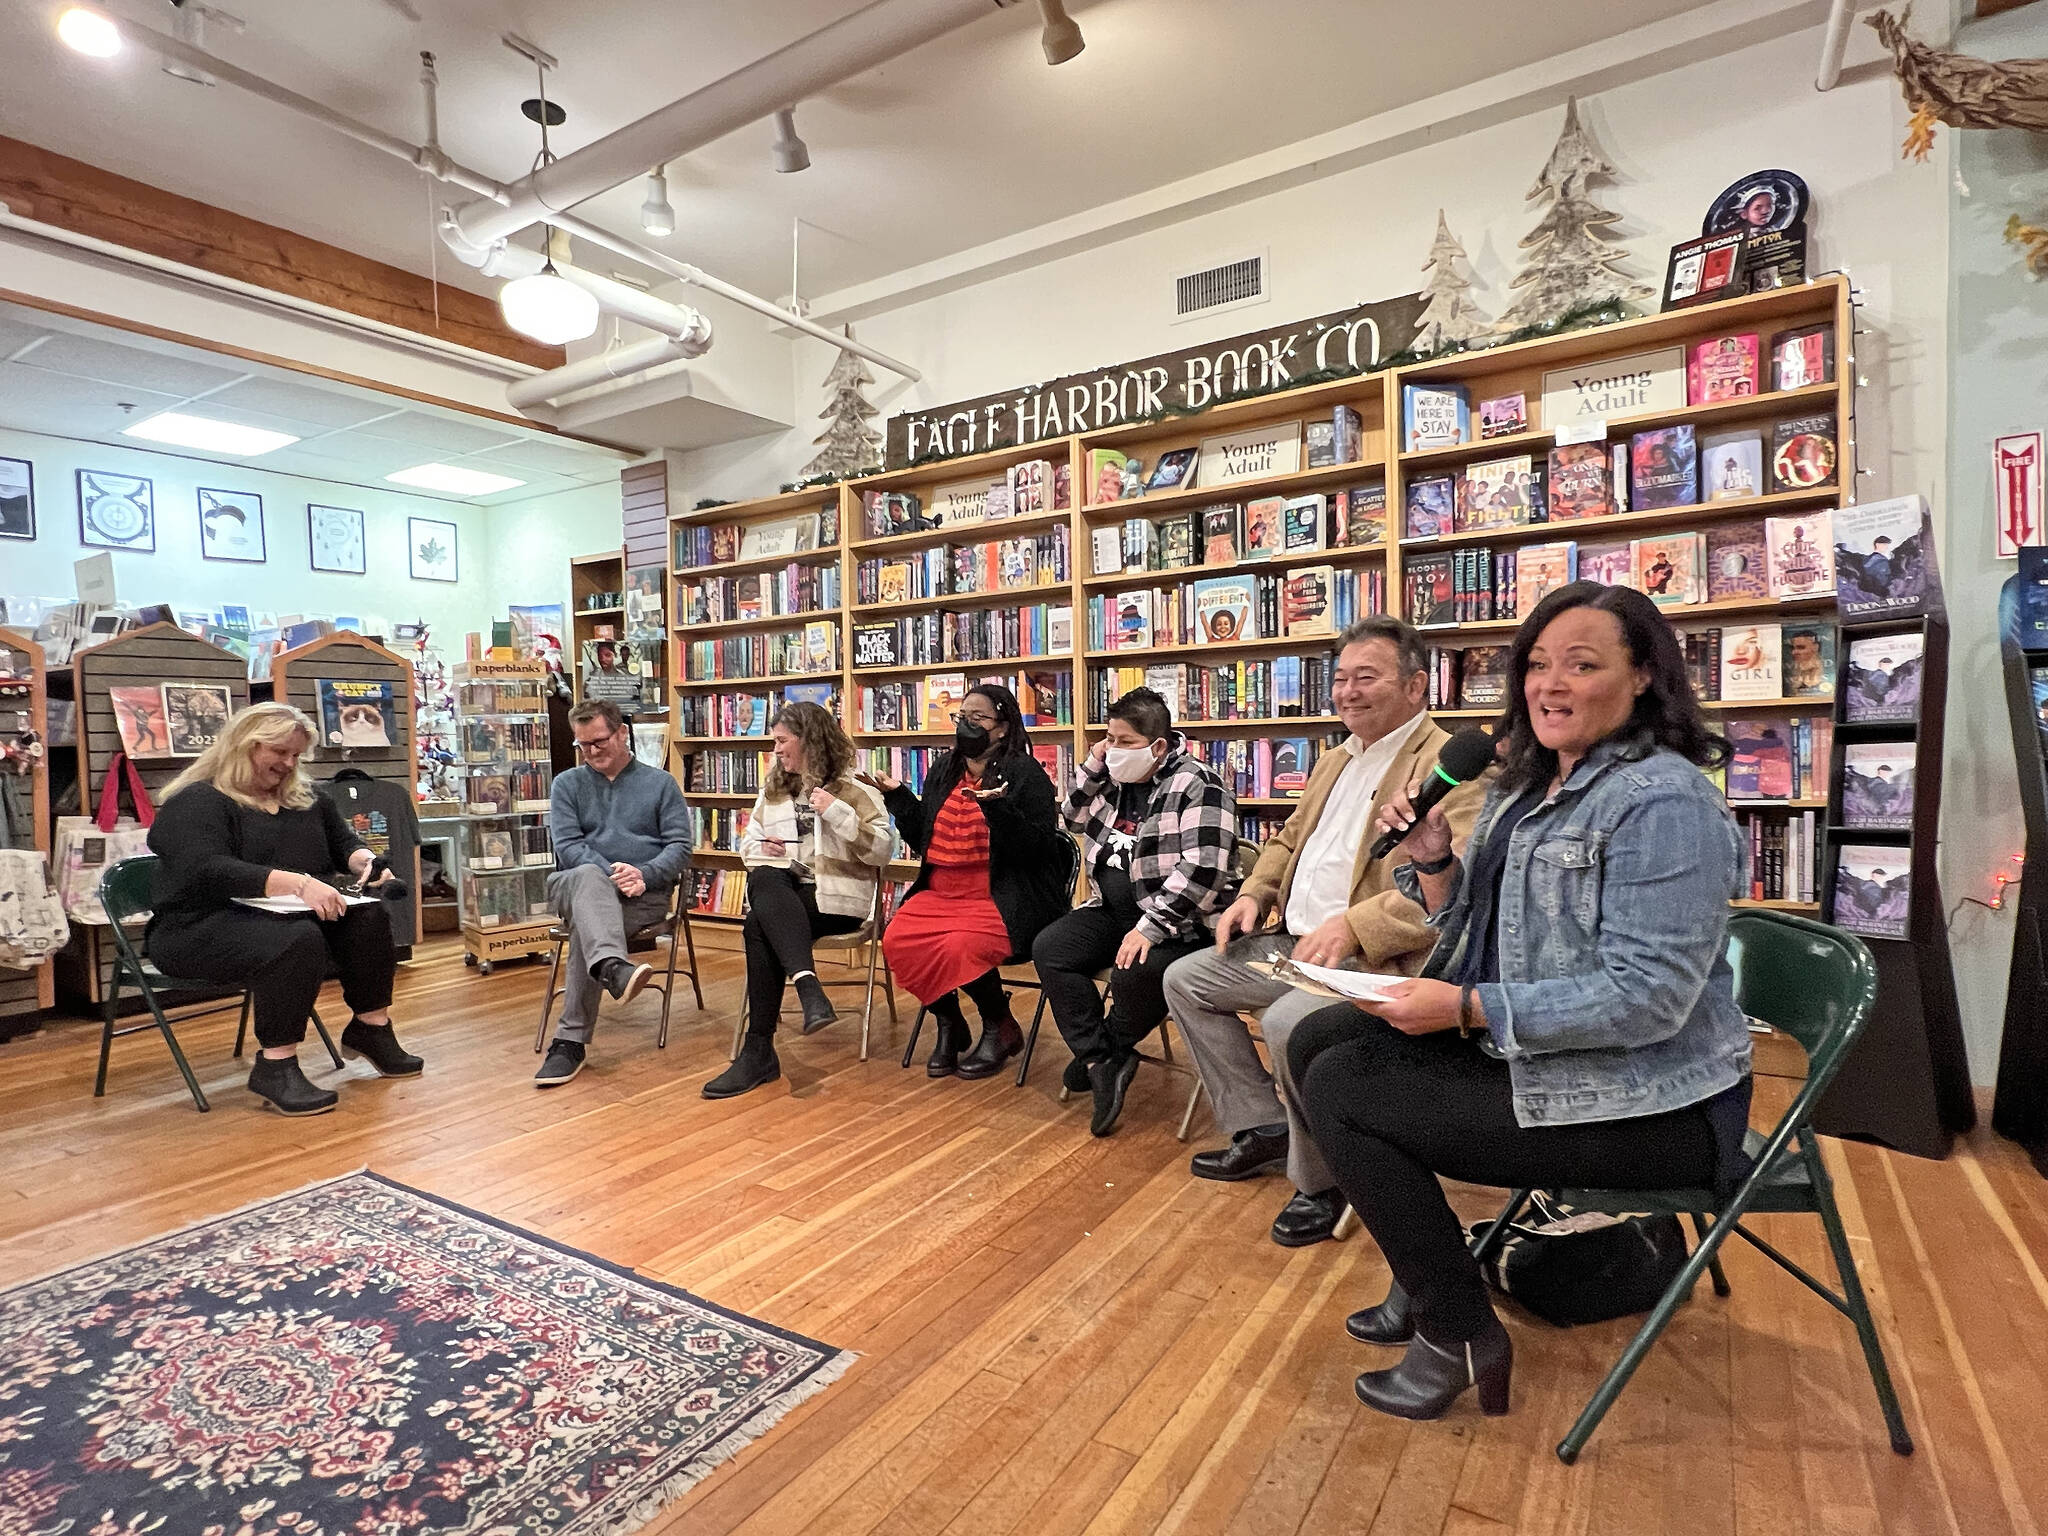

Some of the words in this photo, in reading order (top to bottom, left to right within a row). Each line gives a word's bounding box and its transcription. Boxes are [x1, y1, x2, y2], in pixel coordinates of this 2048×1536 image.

[1674, 245, 1702, 260] ANGIE
[1704, 232, 1744, 250] THOMAS
[1015, 366, 1169, 445] HARBOR
[1184, 334, 1299, 408] BOOK
[1315, 317, 1381, 372] CO
[1571, 370, 1652, 395] Young
[1418, 396, 1432, 406] WE
[1434, 395, 1454, 406] ARE
[1576, 388, 1648, 416] Adult
[1417, 408, 1443, 418] HERE
[1445, 408, 1455, 418] TO
[1421, 421, 1450, 434] STAY
[1221, 438, 1279, 460] Young
[1222, 455, 1273, 478] Adult
[2004, 455, 2032, 468] FIRE
[948, 490, 988, 507] Young
[949, 503, 984, 521] Adult
[1408, 573, 1446, 584] TROY
[858, 633, 890, 645] BLACK
[861, 643, 888, 654] LIVES
[855, 651, 895, 664] MATTER
[475, 664, 541, 675] paperblanks
[1731, 668, 1774, 681] GIRL
[489, 934, 549, 952] paperblank
